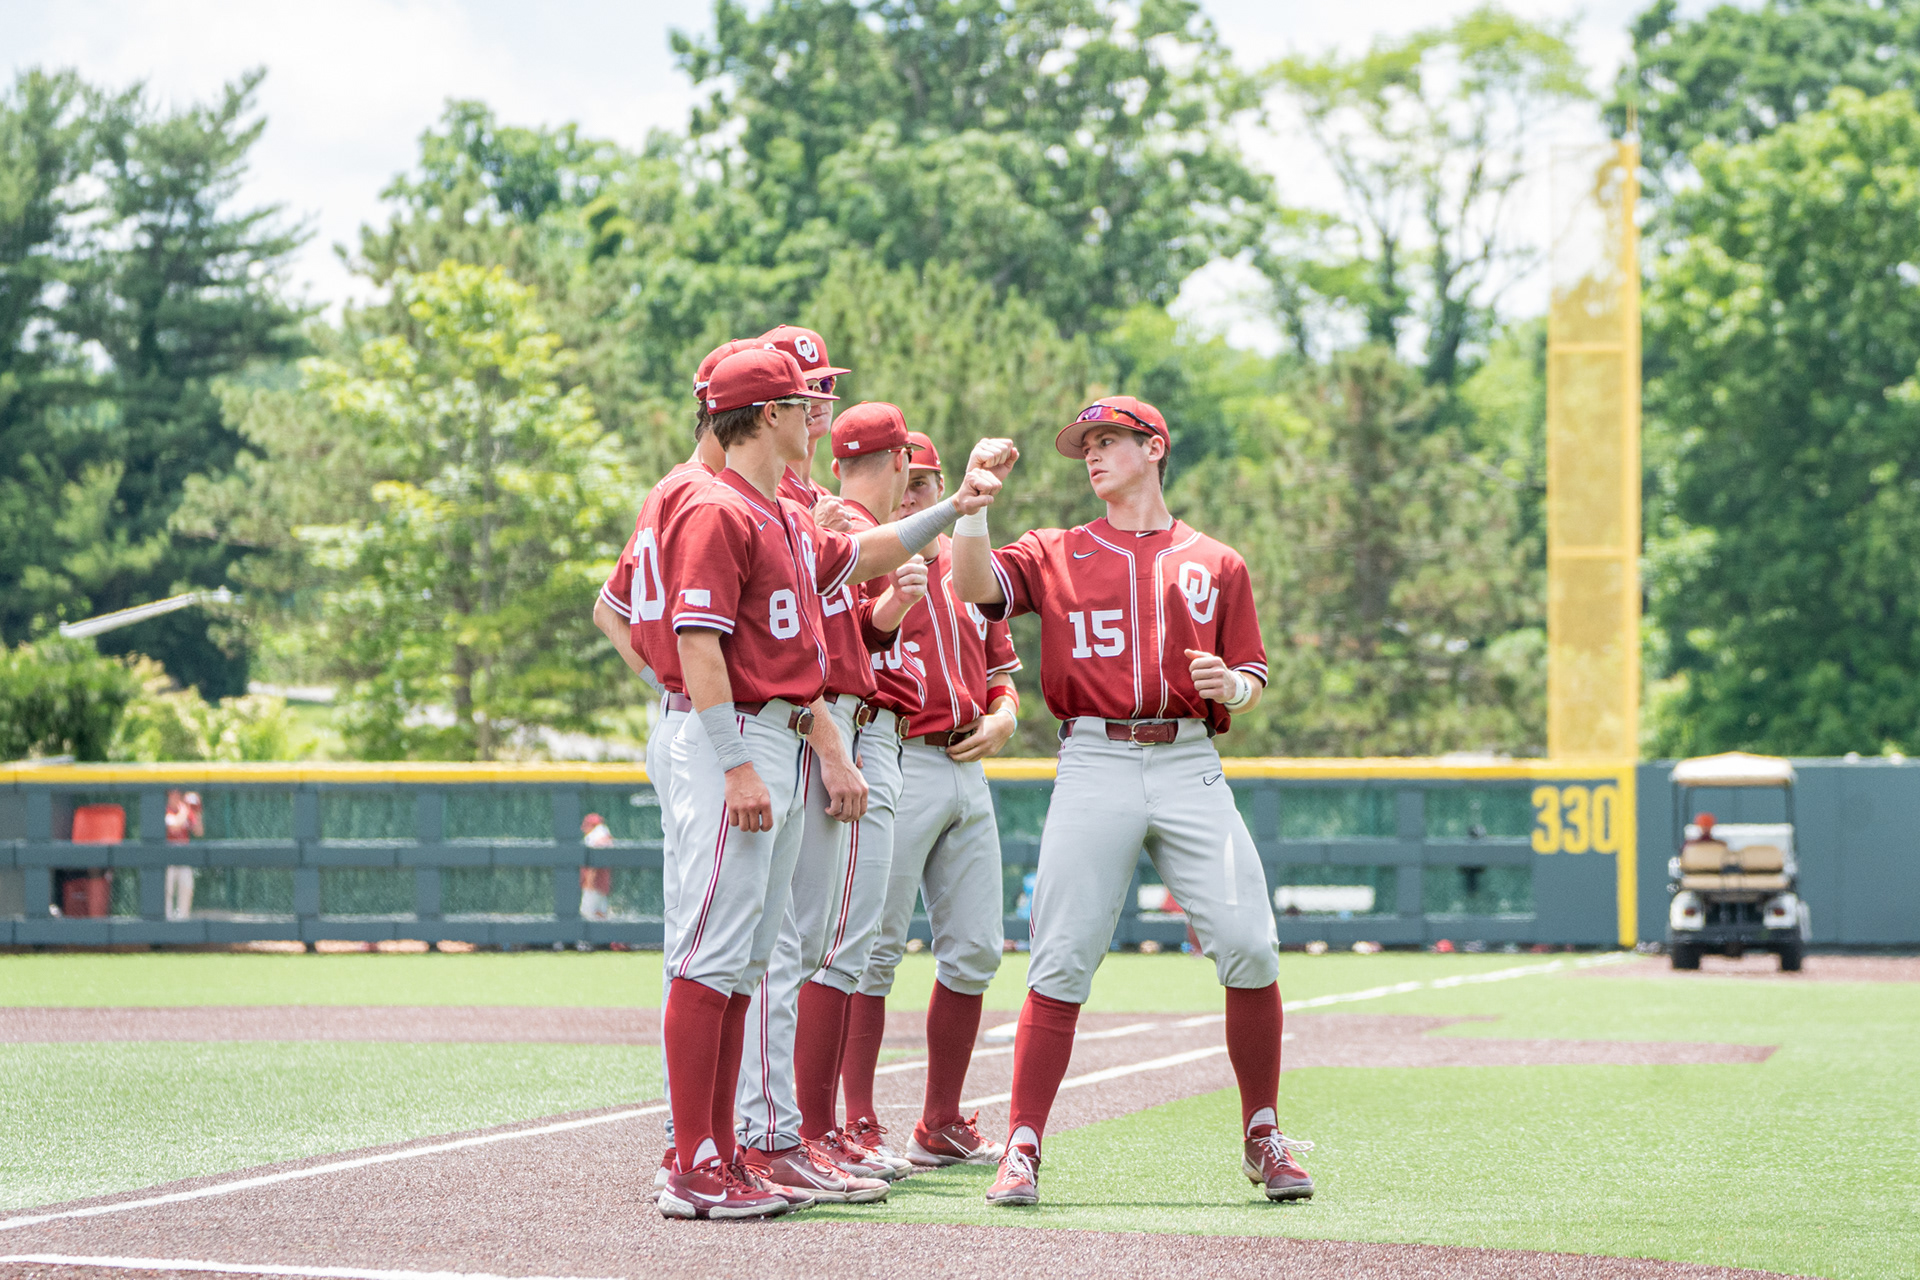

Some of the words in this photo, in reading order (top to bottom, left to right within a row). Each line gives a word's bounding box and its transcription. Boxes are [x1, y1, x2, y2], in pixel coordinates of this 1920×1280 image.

[794, 335, 820, 364] OU
[769, 588, 801, 640] 8
[1178, 560, 1220, 625] OU
[1068, 608, 1126, 659] 15
[1531, 785, 1618, 855] 330
